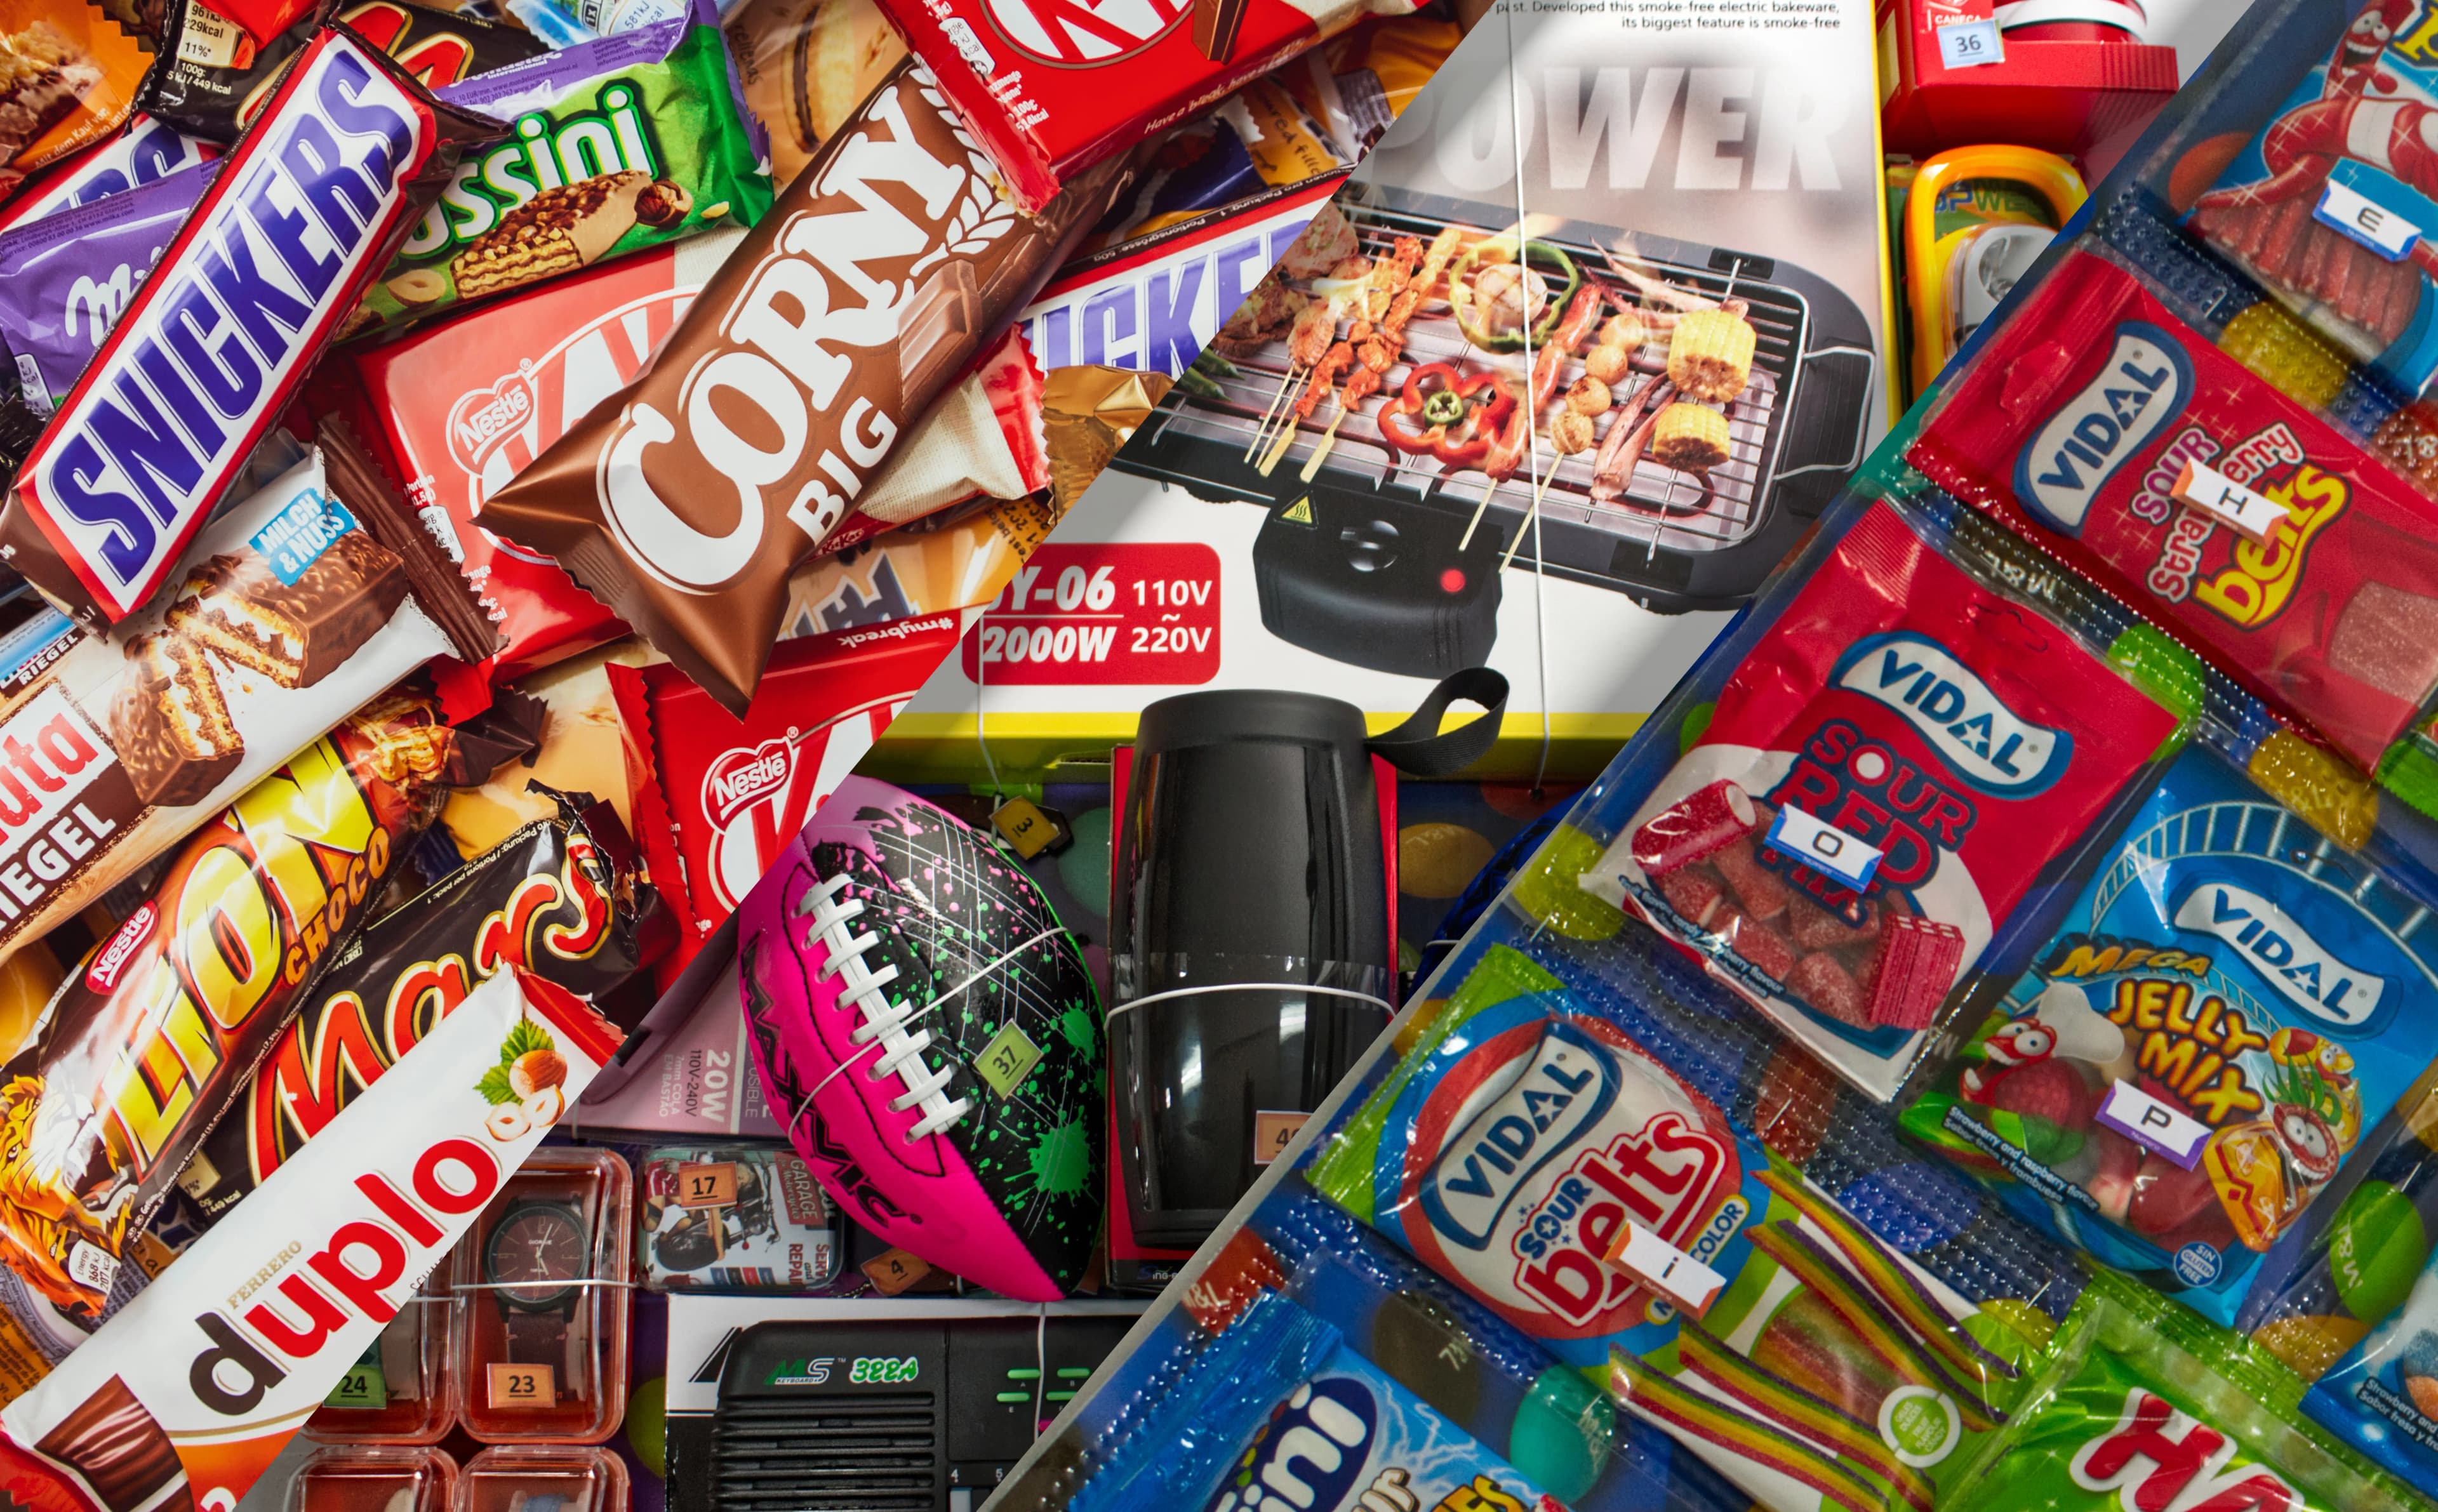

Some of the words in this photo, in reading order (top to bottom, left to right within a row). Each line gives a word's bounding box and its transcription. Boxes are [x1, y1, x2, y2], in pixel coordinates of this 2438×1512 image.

[1531, 0, 1599, 16] Developed
[1603, 0, 1634, 13] this
[1638, 0, 1715, 13] smoke-free
[1719, 0, 1768, 13] electric
[1772, 0, 1840, 15] bakeware,
[1622, 17, 1637, 29] its
[1641, 17, 1692, 32] biggest
[1696, 17, 1745, 29] feature
[1749, 17, 1761, 29] is
[1764, 17, 1841, 29] smoke-free
[1955, 34, 1982, 53] 36
[192, 77, 210, 90] 449
[211, 83, 232, 96] kcal
[2356, 206, 2385, 234] E
[49, 49, 413, 588] SNICKERS
[606, 86, 966, 585] CORNY
[456, 386, 531, 452] Nestlé
[2037, 361, 2171, 492] VIDAL
[787, 395, 898, 547] BIG
[257, 493, 326, 553] MILCH
[277, 547, 300, 574] &
[295, 507, 345, 566] NUSS
[1132, 580, 1213, 607] 110V
[837, 616, 954, 649] #mybreak
[983, 626, 1116, 663] 2000W
[1130, 627, 1213, 654] 220V
[18, 633, 79, 686] RIEGEL
[1877, 649, 2024, 778] VIDAL
[714, 751, 786, 809] Nestlé
[1811, 724, 1973, 846] SOUR
[501, 825, 538, 854] Packung:
[284, 825, 392, 988] CHOCO
[92, 903, 150, 983] Nestlé
[102, 735, 376, 1163] LION
[2050, 945, 2211, 979] MEGA
[2212, 888, 2356, 1021] VIDAL
[2110, 979, 2266, 1052] JELLY
[684, 1049, 702, 1118] 110V-240V
[700, 1049, 731, 1123] 20W
[993, 1045, 1017, 1075] 37
[2140, 1033, 2262, 1125] MIX
[1446, 1063, 1595, 1199] VIDAL
[2140, 1104, 2172, 1130] P
[1948, 1106, 2002, 1148] Strawberry
[2001, 1141, 2025, 1159] and
[2020, 1153, 2067, 1191] raspberry
[691, 1177, 716, 1196] 17
[789, 1158, 819, 1220] GARAGE
[2009, 1161, 2064, 1204] frambuesa
[1519, 1177, 1593, 1259] SOUR
[75, 1249, 90, 1276] Energy
[89, 1264, 100, 1283] 868
[190, 1139, 500, 1416] duplo
[227, 1240, 303, 1311] FERRERO
[2178, 1263, 2203, 1284] FREE
[2196, 1245, 2216, 1263] SIN
[100, 1272, 111, 1291] 207
[340, 1375, 369, 1395] 24
[509, 1375, 536, 1395] 23
[2361, 1390, 2391, 1416] Sabor
[2390, 1410, 2416, 1433] fresa
[2368, 1378, 2420, 1416] Strawberry
[2418, 1410, 2438, 1429] and
[951, 1468, 959, 1480] 4
[996, 1468, 1003, 1480] 5
